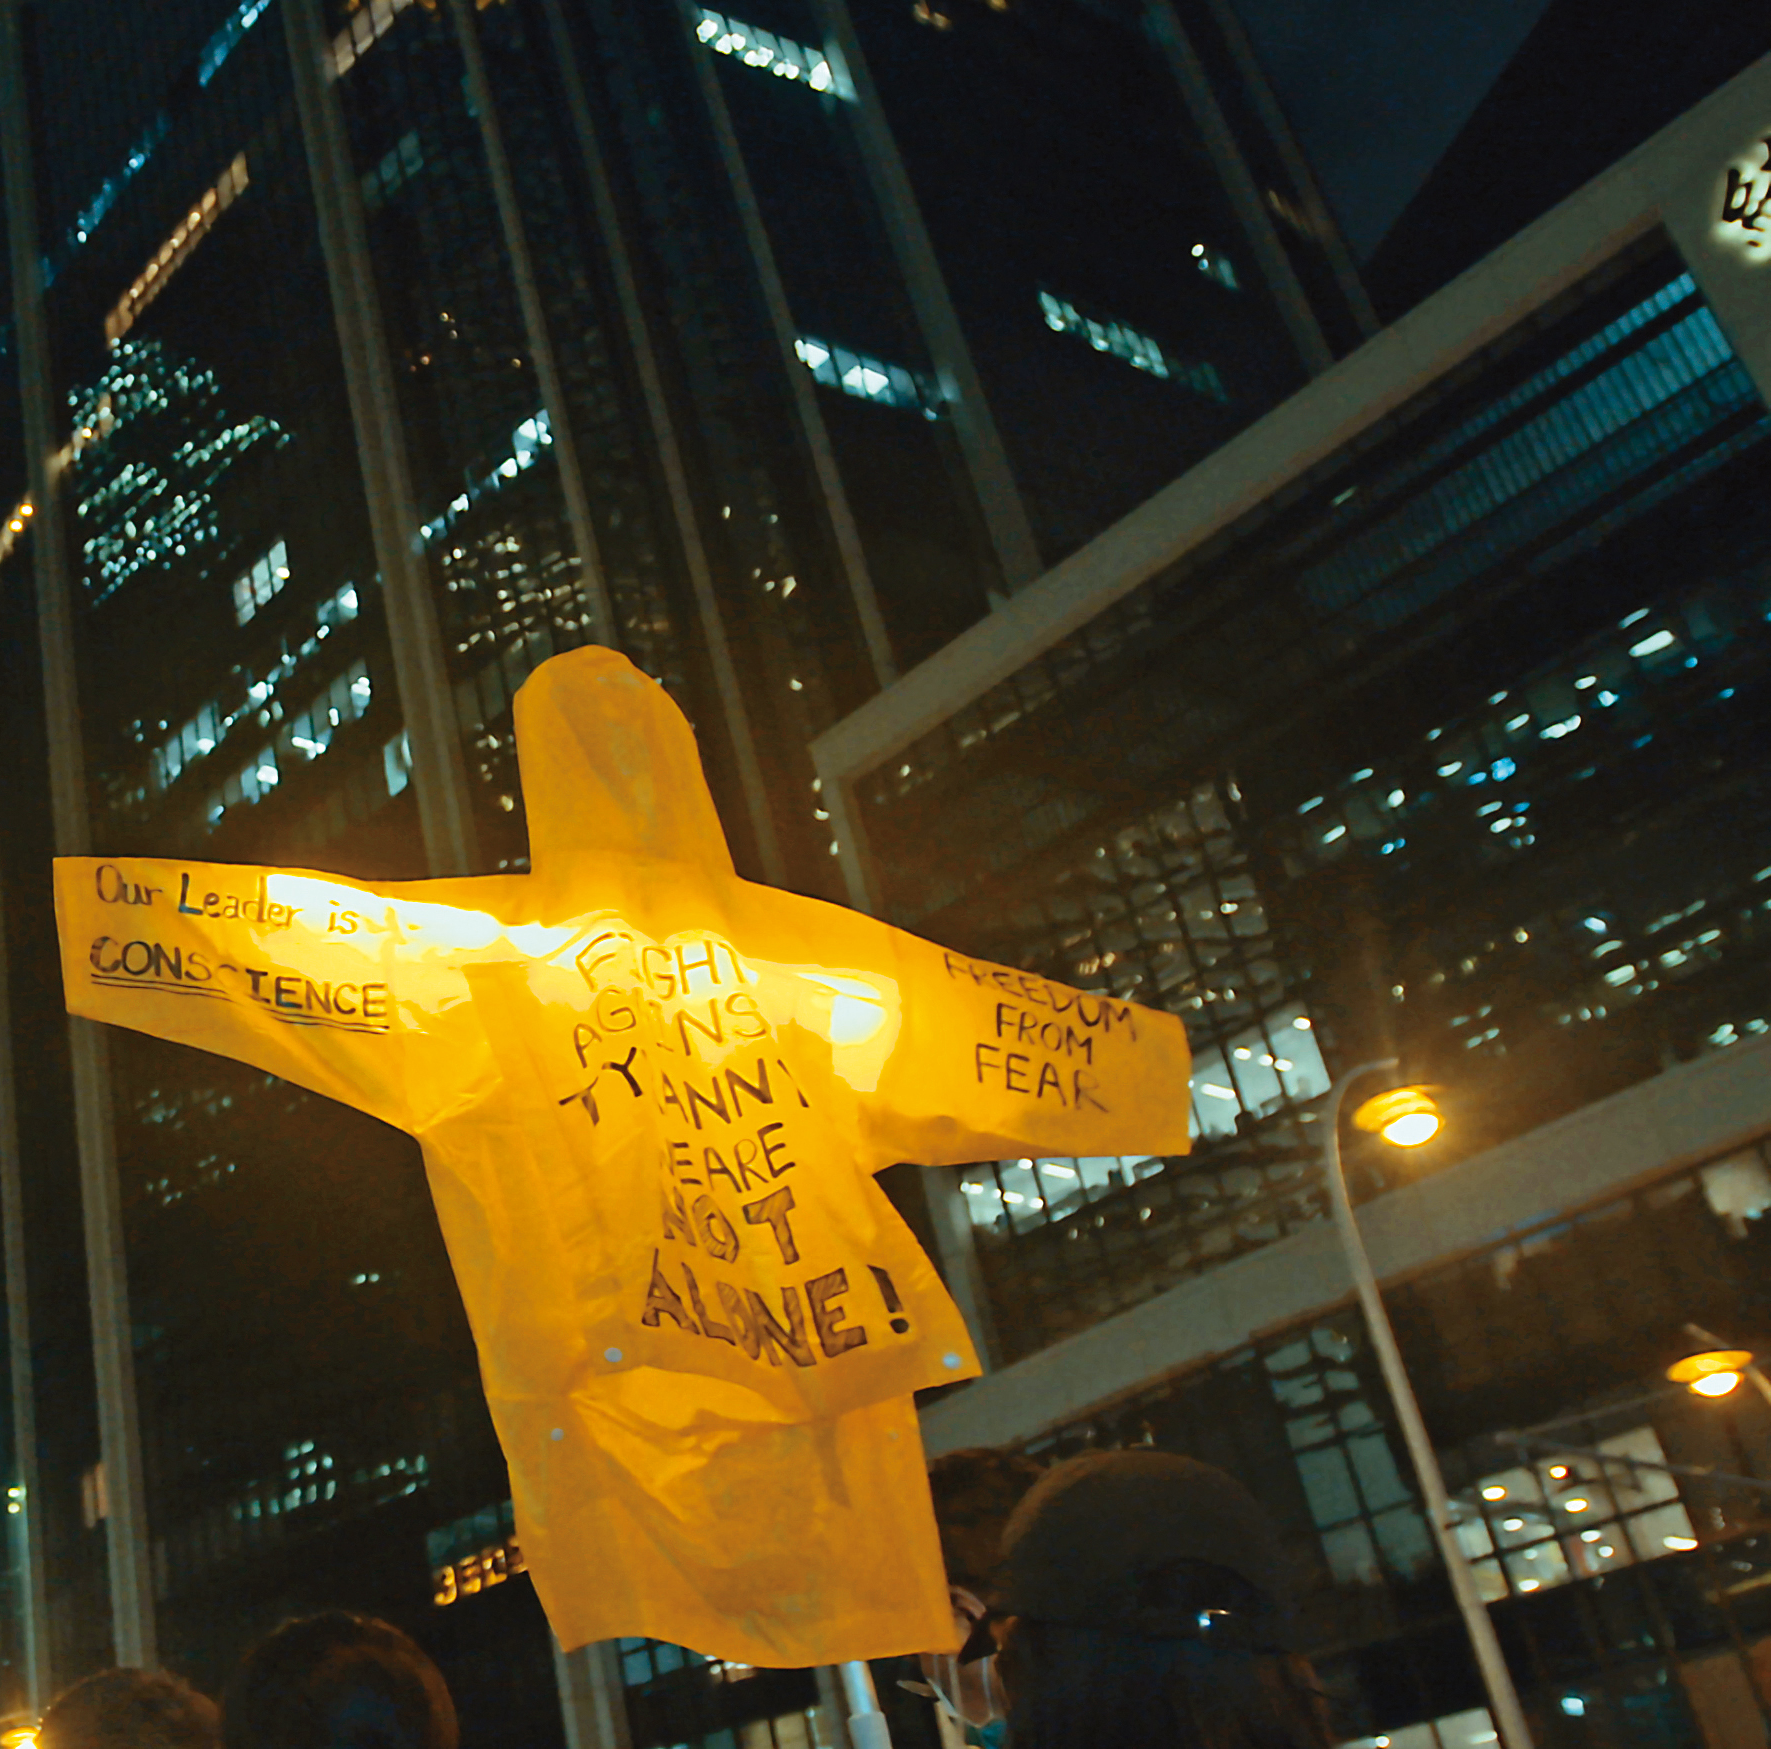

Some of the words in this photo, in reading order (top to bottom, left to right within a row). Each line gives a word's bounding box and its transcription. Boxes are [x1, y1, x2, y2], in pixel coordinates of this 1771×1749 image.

[95, 864, 163, 906] Our
[178, 873, 304, 927] Leader
[329, 901, 360, 935] is
[996, 1002, 1093, 1065] FROM
[558, 1046, 810, 1129] TYANN
[975, 1042, 1110, 1114] FEAR
[661, 1184, 800, 1265] NOT
